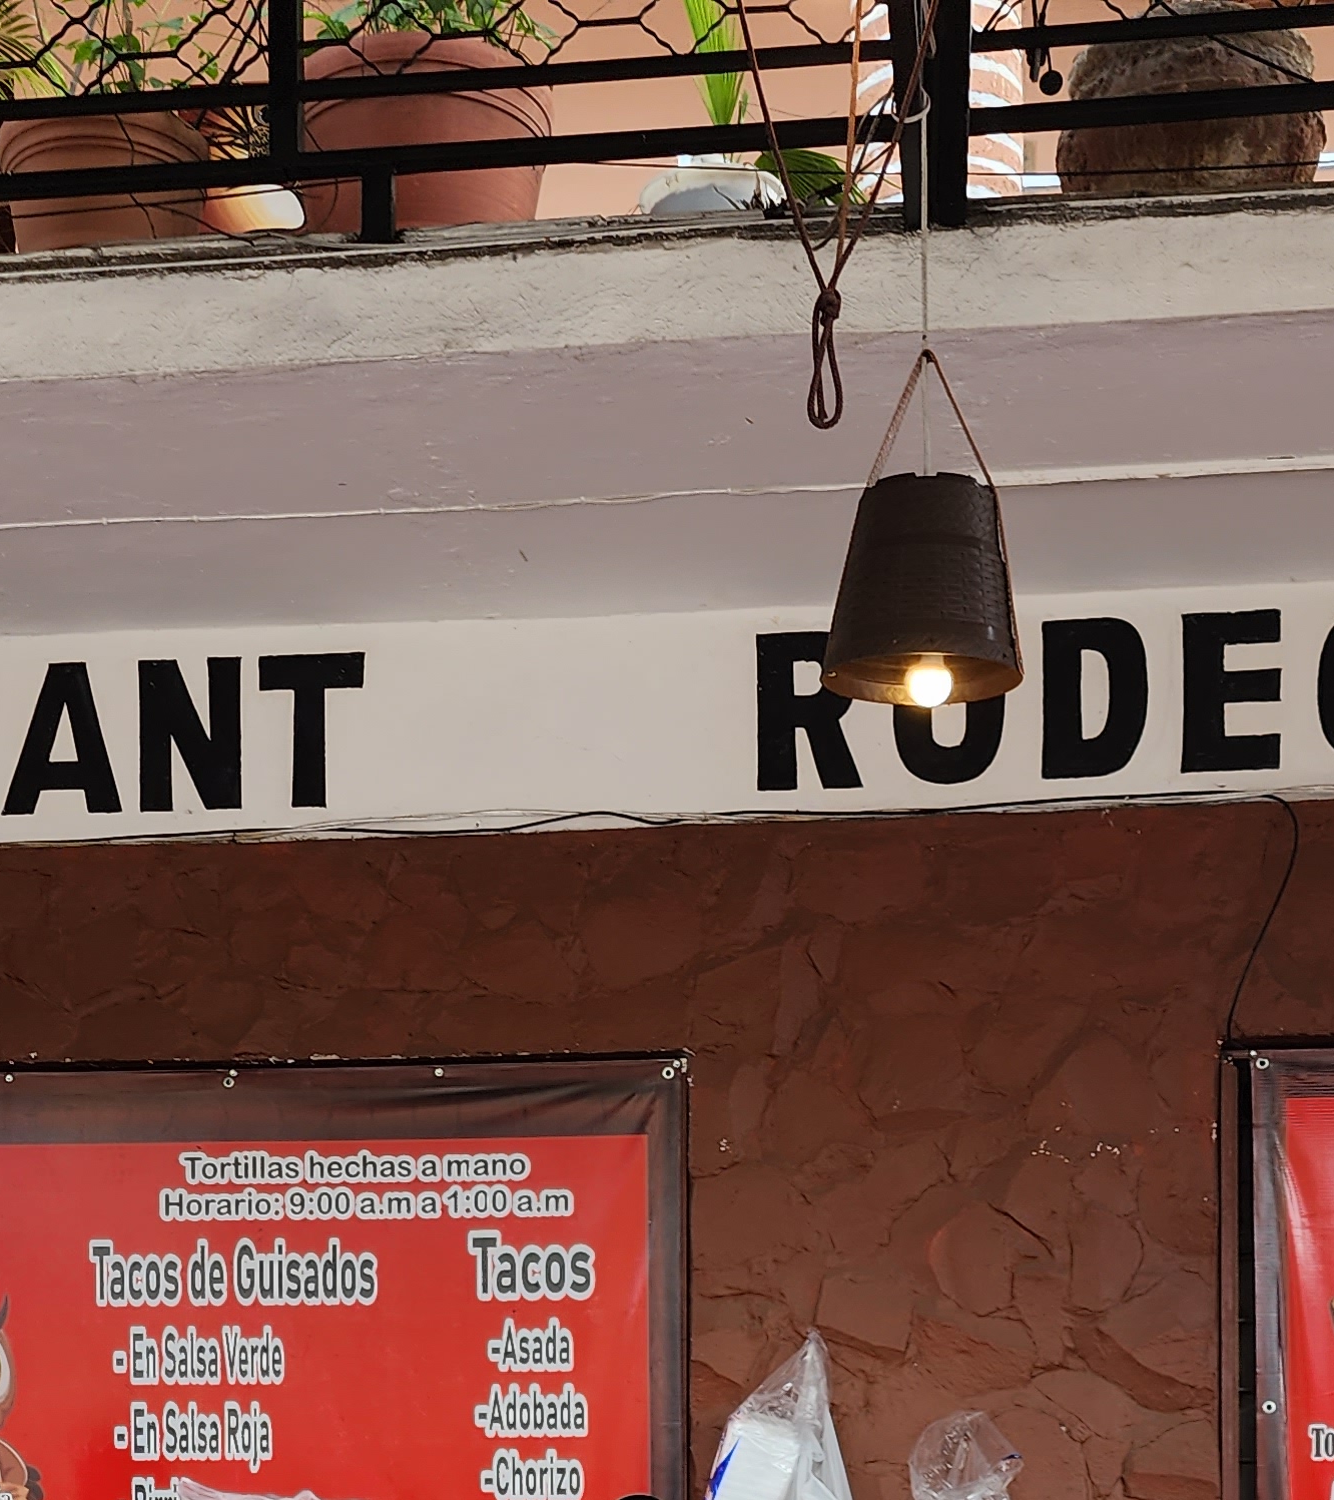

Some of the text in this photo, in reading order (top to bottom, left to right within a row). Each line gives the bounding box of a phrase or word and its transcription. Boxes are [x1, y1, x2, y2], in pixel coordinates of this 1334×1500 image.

[182, 1153, 527, 1181] Tortillas hechas a mano
[163, 1188, 570, 1218] Horario: 9:00 a.m a 1:00 a.m
[91, 1242, 376, 1302] Tacos de Guisados
[471, 1235, 592, 1296] Tacos
[131, 1331, 283, 1380] En Salsa Verde
[132, 1407, 271, 1468] En Salsa Roja
